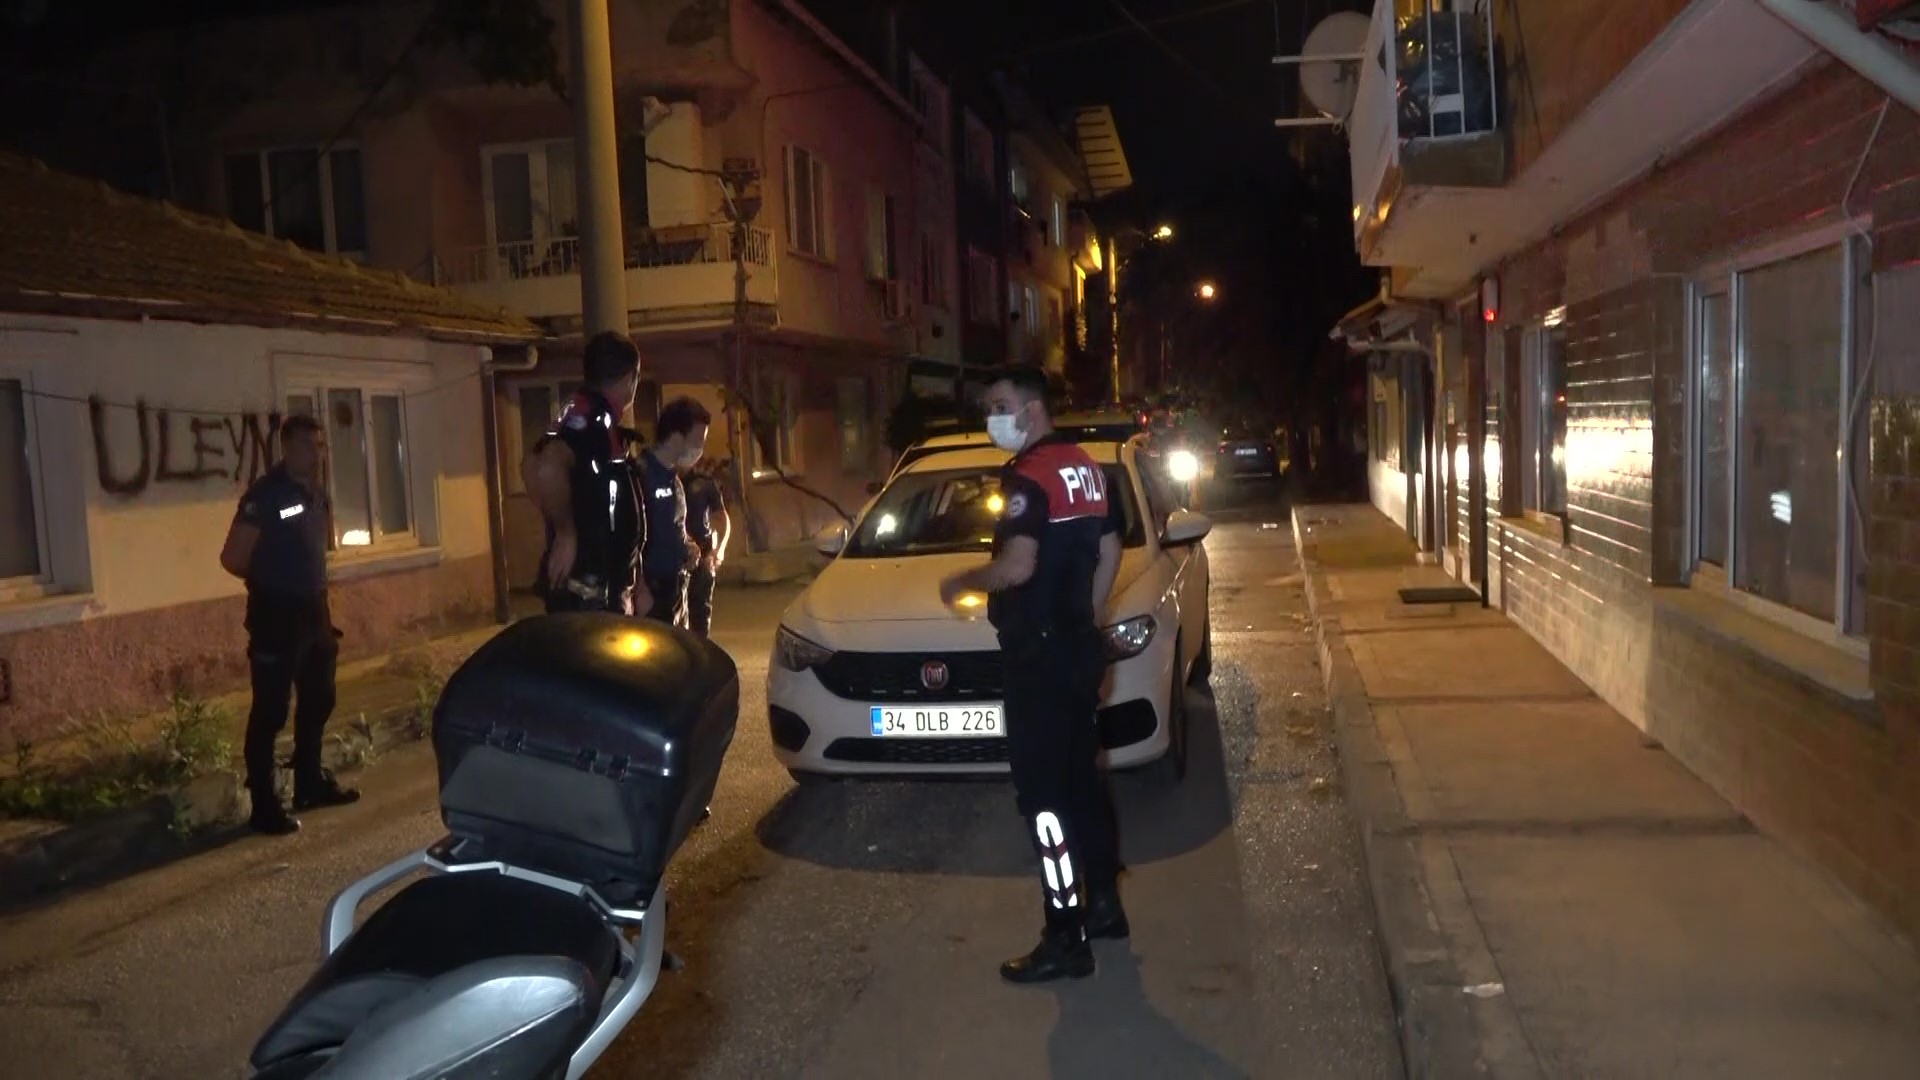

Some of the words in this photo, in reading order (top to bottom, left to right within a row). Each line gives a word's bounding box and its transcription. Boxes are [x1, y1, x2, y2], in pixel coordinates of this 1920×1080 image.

[885, 711, 906, 732] 34
[915, 711, 949, 732] DLB
[961, 710, 996, 732] 226
